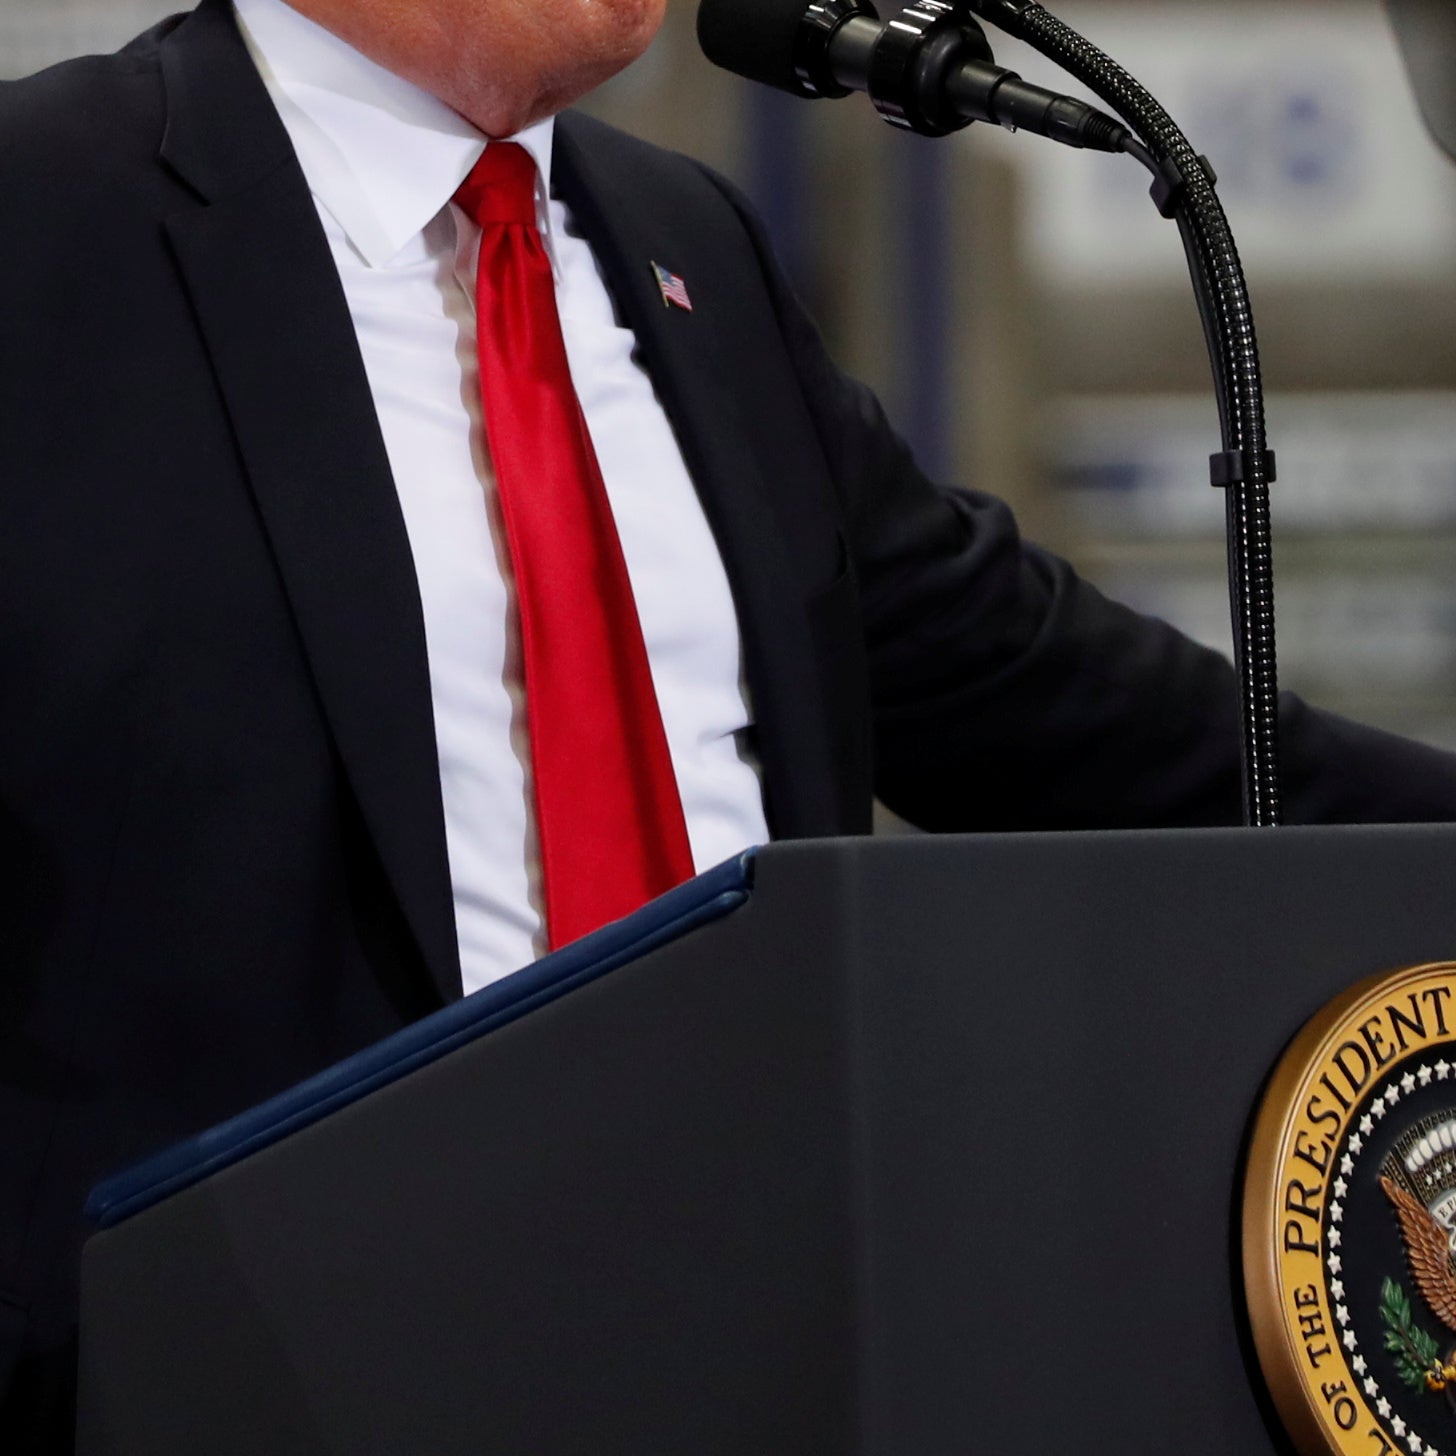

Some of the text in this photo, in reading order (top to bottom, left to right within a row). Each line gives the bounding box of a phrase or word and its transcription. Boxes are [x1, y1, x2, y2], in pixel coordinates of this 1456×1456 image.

[1284, 986, 1452, 1258] PRESIDENT
[1438, 1208, 1449, 1219] E
[1294, 1284, 1331, 1369] THE
[1321, 1381, 1357, 1430] OF
